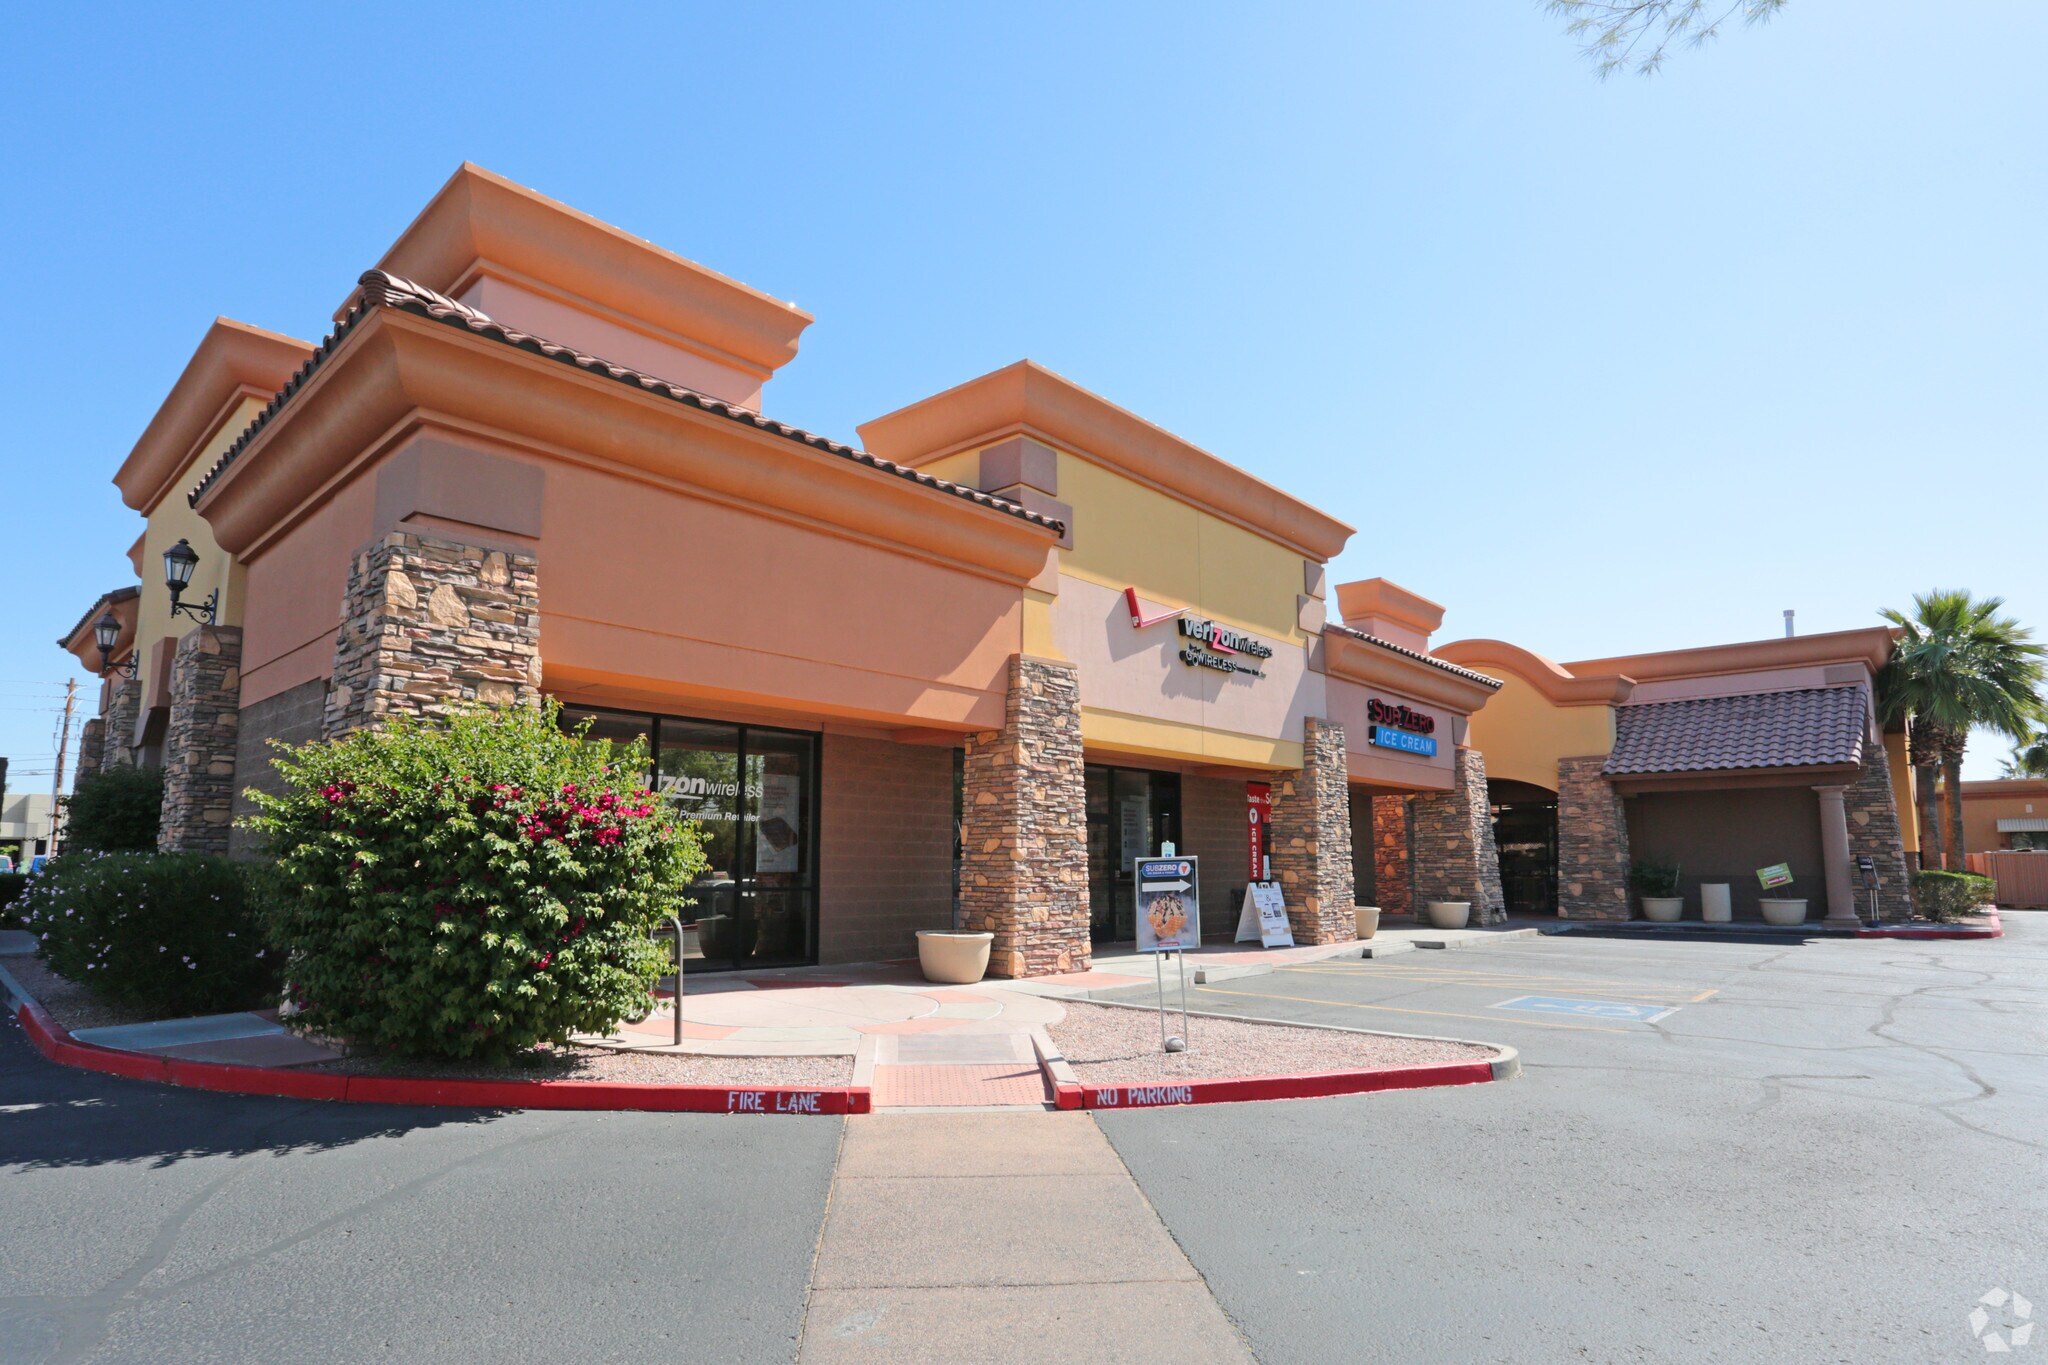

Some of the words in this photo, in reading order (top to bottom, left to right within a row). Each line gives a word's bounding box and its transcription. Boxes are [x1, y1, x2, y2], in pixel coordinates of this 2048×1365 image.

[1380, 730, 1397, 746] ICE
[1401, 735, 1433, 753] CREAM
[679, 809, 722, 820] Premium
[1145, 864, 1178, 872] SUBZERO
[728, 1091, 766, 1111] FIRE
[776, 1092, 822, 1112] LANE
[1097, 1088, 1118, 1106] NO
[1128, 1085, 1193, 1105] PARKING
